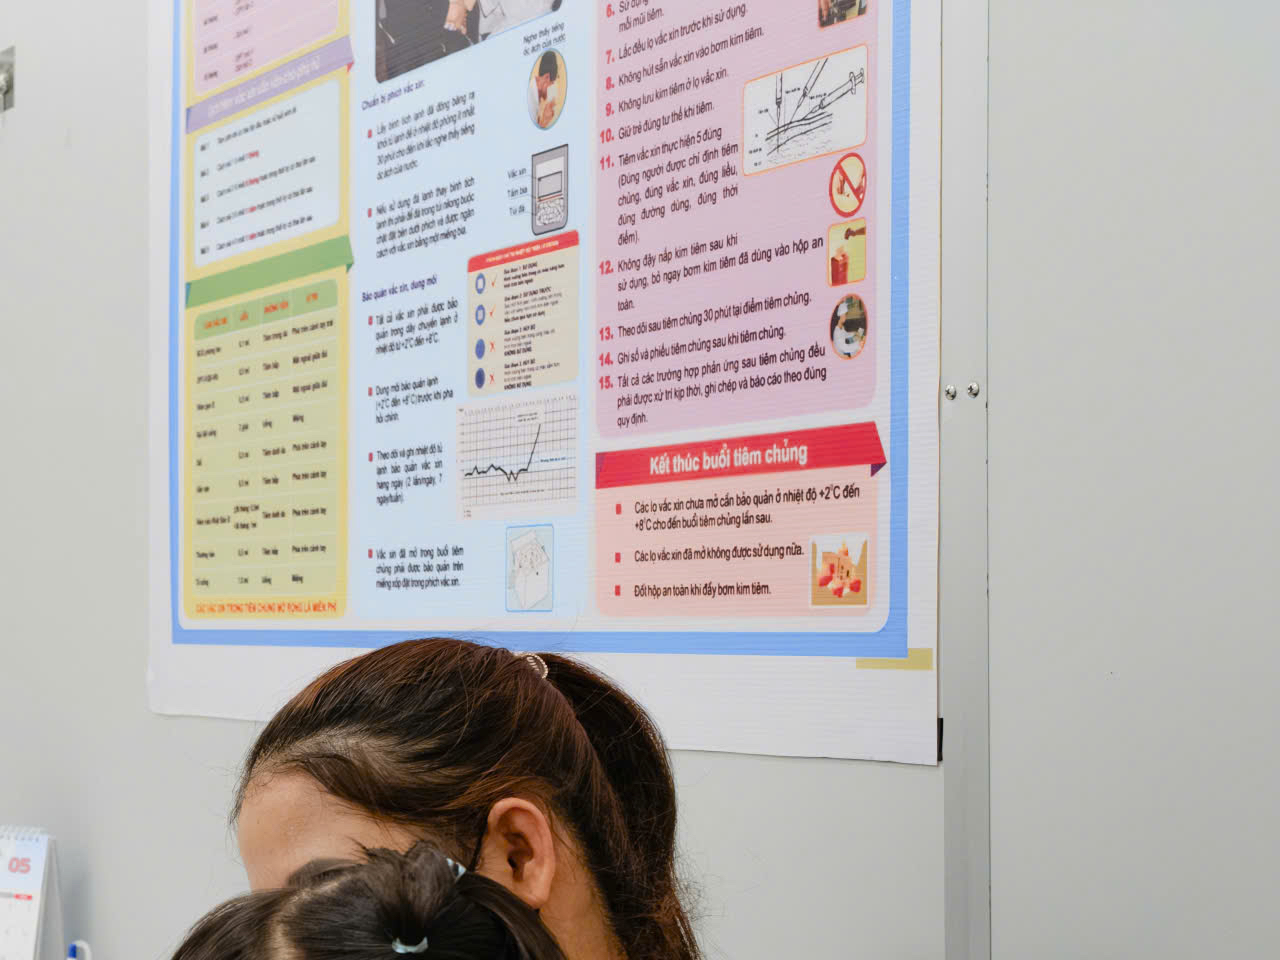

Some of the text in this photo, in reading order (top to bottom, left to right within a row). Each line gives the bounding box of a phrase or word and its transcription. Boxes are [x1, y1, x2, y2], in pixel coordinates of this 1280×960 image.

[618, 143, 738, 189] (Đúng người được chỉ định tiêm
[599, 234, 738, 276] 12. Không đậy nắp kim tiêm sau khi
[618, 237, 824, 292] sử dụng, bỏ ngay bơm kim tiêm đã dùng vào hộp an
[617, 298, 635, 312] toàn.
[599, 375, 614, 390] 15.
[630, 373, 640, 387] cả
[641, 372, 655, 385] các
[656, 369, 682, 382] trường
[684, 366, 700, 379] hợp
[701, 360, 721, 378] phản
[723, 360, 739, 374] ứng
[741, 357, 757, 369] sau
[759, 352, 777, 366] tiêm
[779, 347, 805, 363] chủng
[808, 342, 826, 359] đều
[650, 439, 807, 476] Kết thúc buổi tiêm chủng
[634, 501, 649, 514] Các
[650, 501, 657, 515] lọ
[658, 498, 672, 512] vắc
[673, 501, 684, 511] xin
[685, 498, 704, 511] chưa
[705, 494, 718, 509] mở
[719, 493, 734, 508] cần
[736, 492, 751, 507] bảo
[753, 490, 774, 508] quản
[775, 488, 781, 504] ở
[782, 489, 804, 505] nhiệt
[806, 487, 817, 502] độ
[842, 483, 860, 499] đến
[652, 518, 666, 531] cho
[667, 516, 681, 530] đến
[682, 513, 698, 529] buổi
[699, 515, 715, 528] tiêm
[716, 512, 741, 529] chủng
[742, 510, 754, 525] lần
[755, 514, 773, 524] sau.
[634, 542, 804, 564] Các lọ vắc xin đã mở không được sử dụng nữa.
[633, 584, 647, 598] Đốt
[647, 584, 661, 600] hộp
[662, 586, 671, 597] an
[672, 584, 689, 597] toàn
[690, 584, 701, 596] khi
[717, 584, 735, 596] bơm
[735, 583, 750, 595] kim
[751, 582, 771, 595] tiêm.
[8, 857, 31, 874] 05
